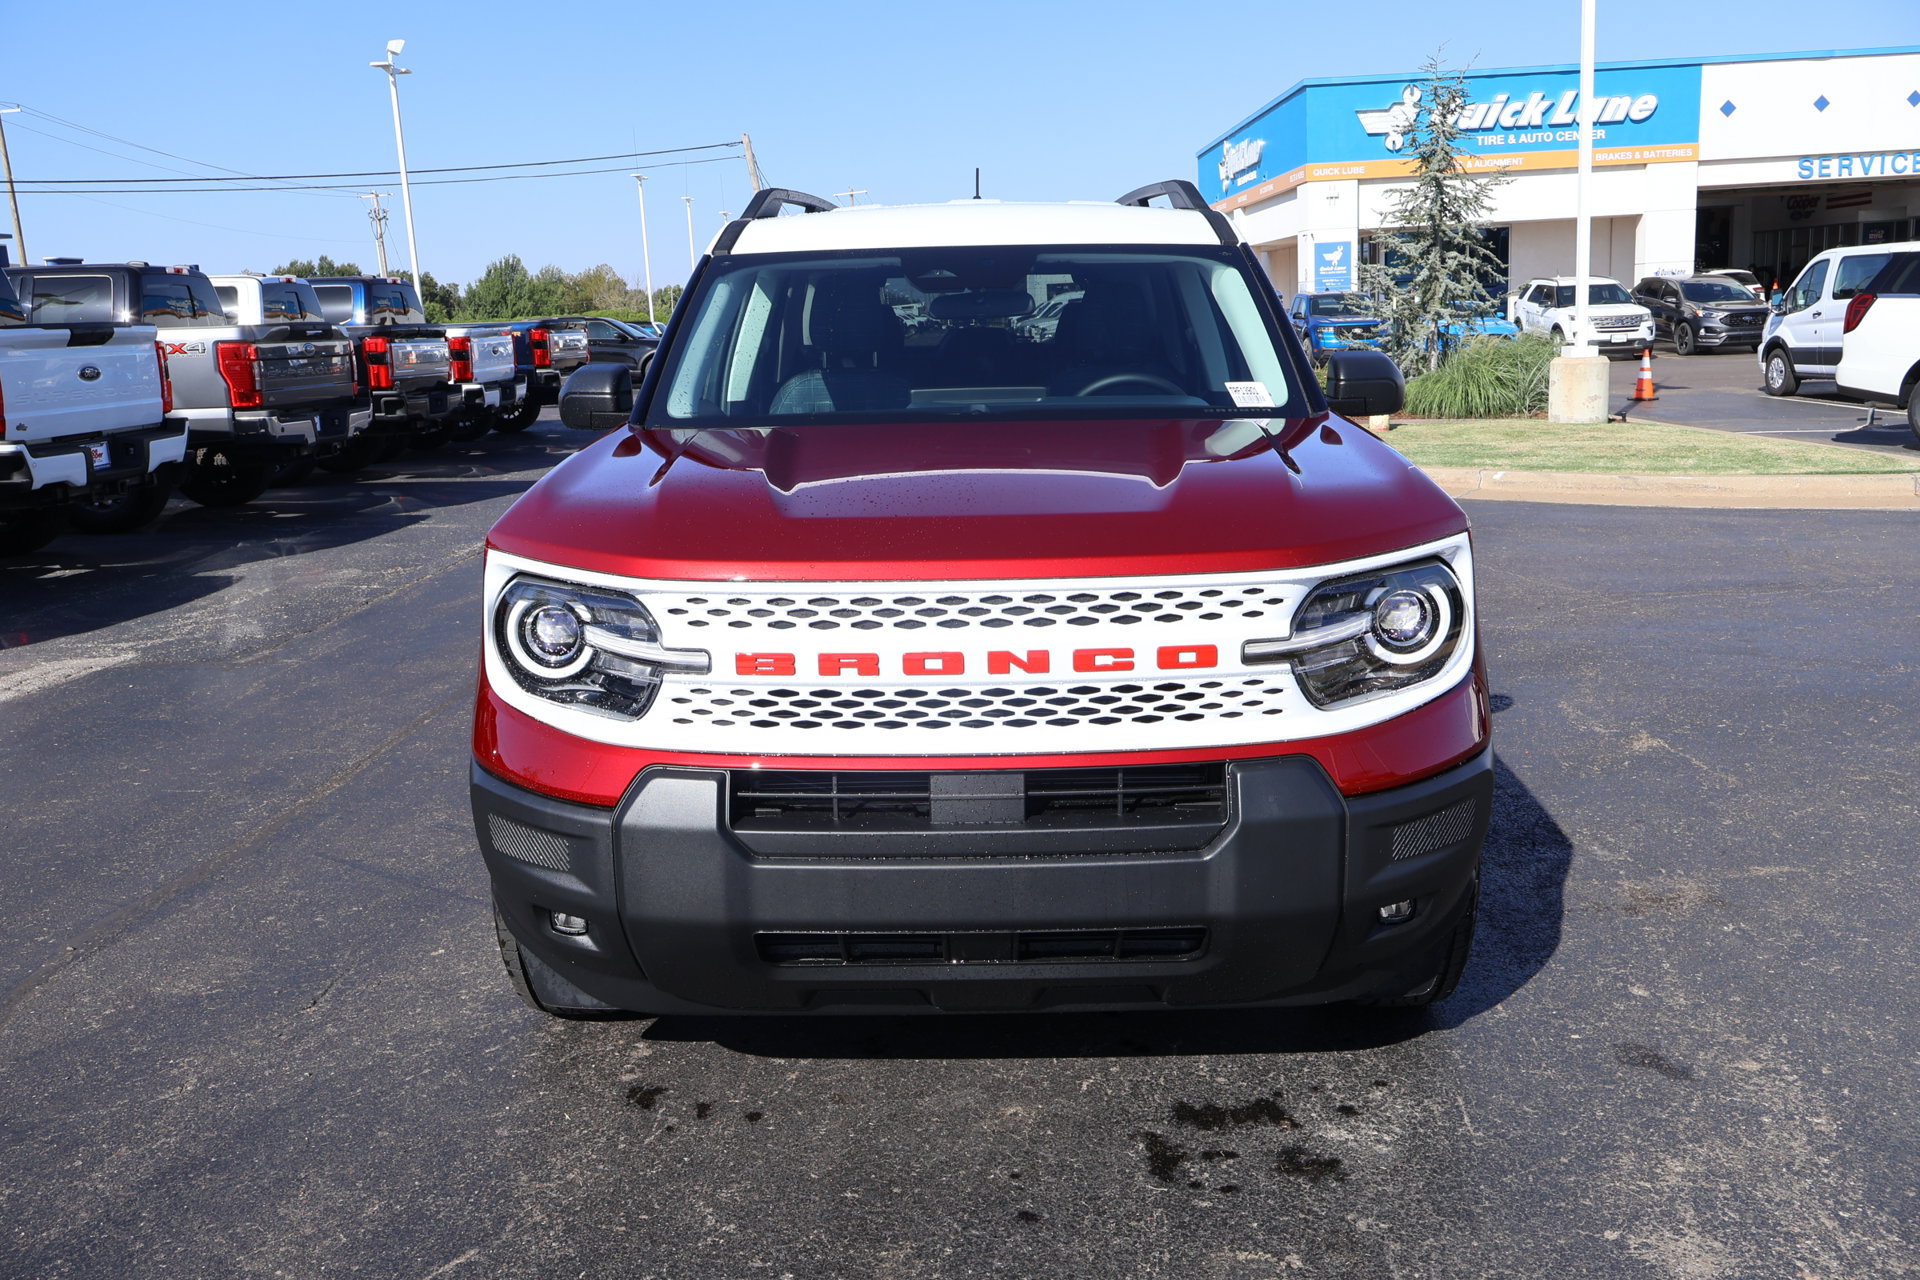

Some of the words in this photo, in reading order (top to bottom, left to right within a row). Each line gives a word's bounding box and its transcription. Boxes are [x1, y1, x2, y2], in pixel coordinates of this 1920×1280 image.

[1477, 134, 1505, 146] TIRE
[1507, 134, 1516, 145] &
[1518, 132, 1553, 144] AUTO
[1556, 129, 1606, 142] CENER
[1595, 151, 1632, 161] BRAKES
[1634, 151, 1641, 159] &
[1643, 148, 1693, 159] BATTERIES
[1474, 157, 1524, 168] ALIGNMENT
[1797, 151, 1920, 179] SERVICE
[1313, 167, 1340, 176] QUICK
[1341, 166, 1365, 175] LUBE
[165, 342, 206, 355] X4
[15, 387, 97, 406] SUPER
[735, 644, 1218, 676] BRONCO
